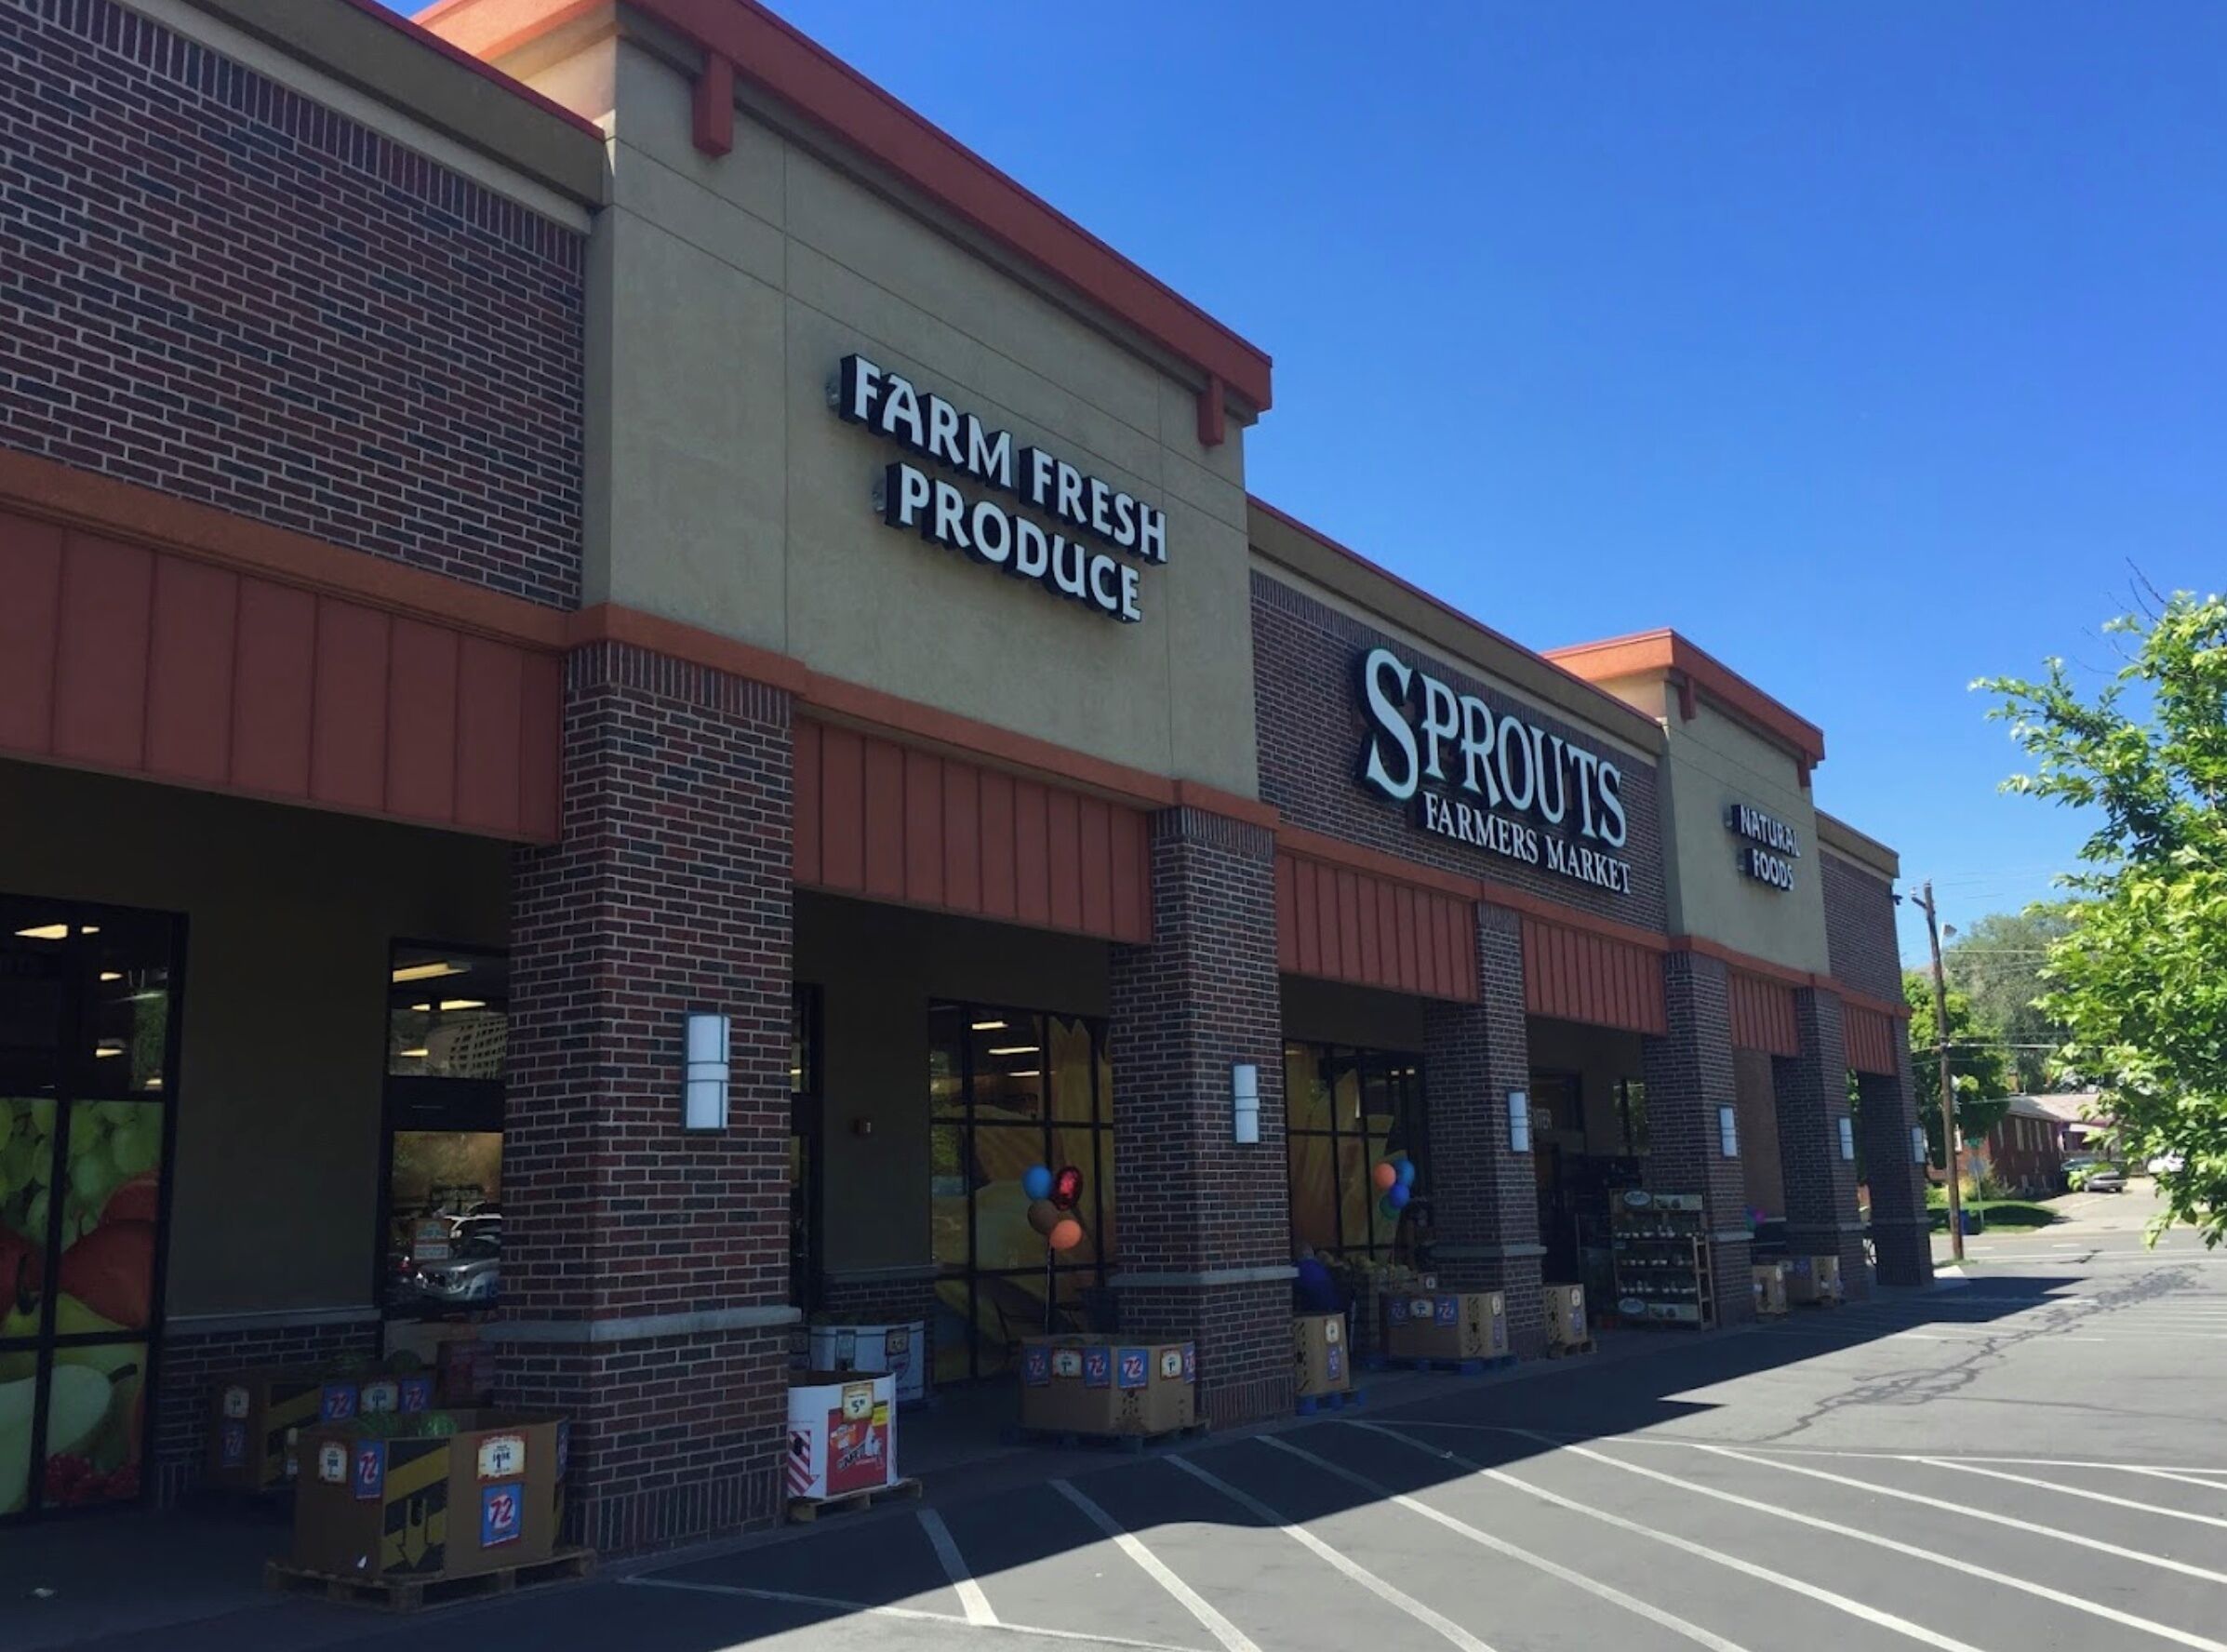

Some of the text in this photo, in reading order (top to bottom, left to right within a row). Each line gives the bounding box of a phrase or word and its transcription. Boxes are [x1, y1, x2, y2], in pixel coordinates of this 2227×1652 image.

[855, 353, 1167, 564] FARM FRESH
[900, 463, 1141, 621] PRODUCE
[1365, 647, 1627, 848] SPROUTS
[1422, 791, 1632, 895] FARMERS MARKET
[1740, 804, 1802, 858] NATURAL
[1752, 848, 1794, 891] FOODS
[1087, 1356, 1104, 1374] 72
[1123, 1358, 1142, 1375] 72
[360, 1454, 378, 1479] 72
[490, 1496, 513, 1525] 72
